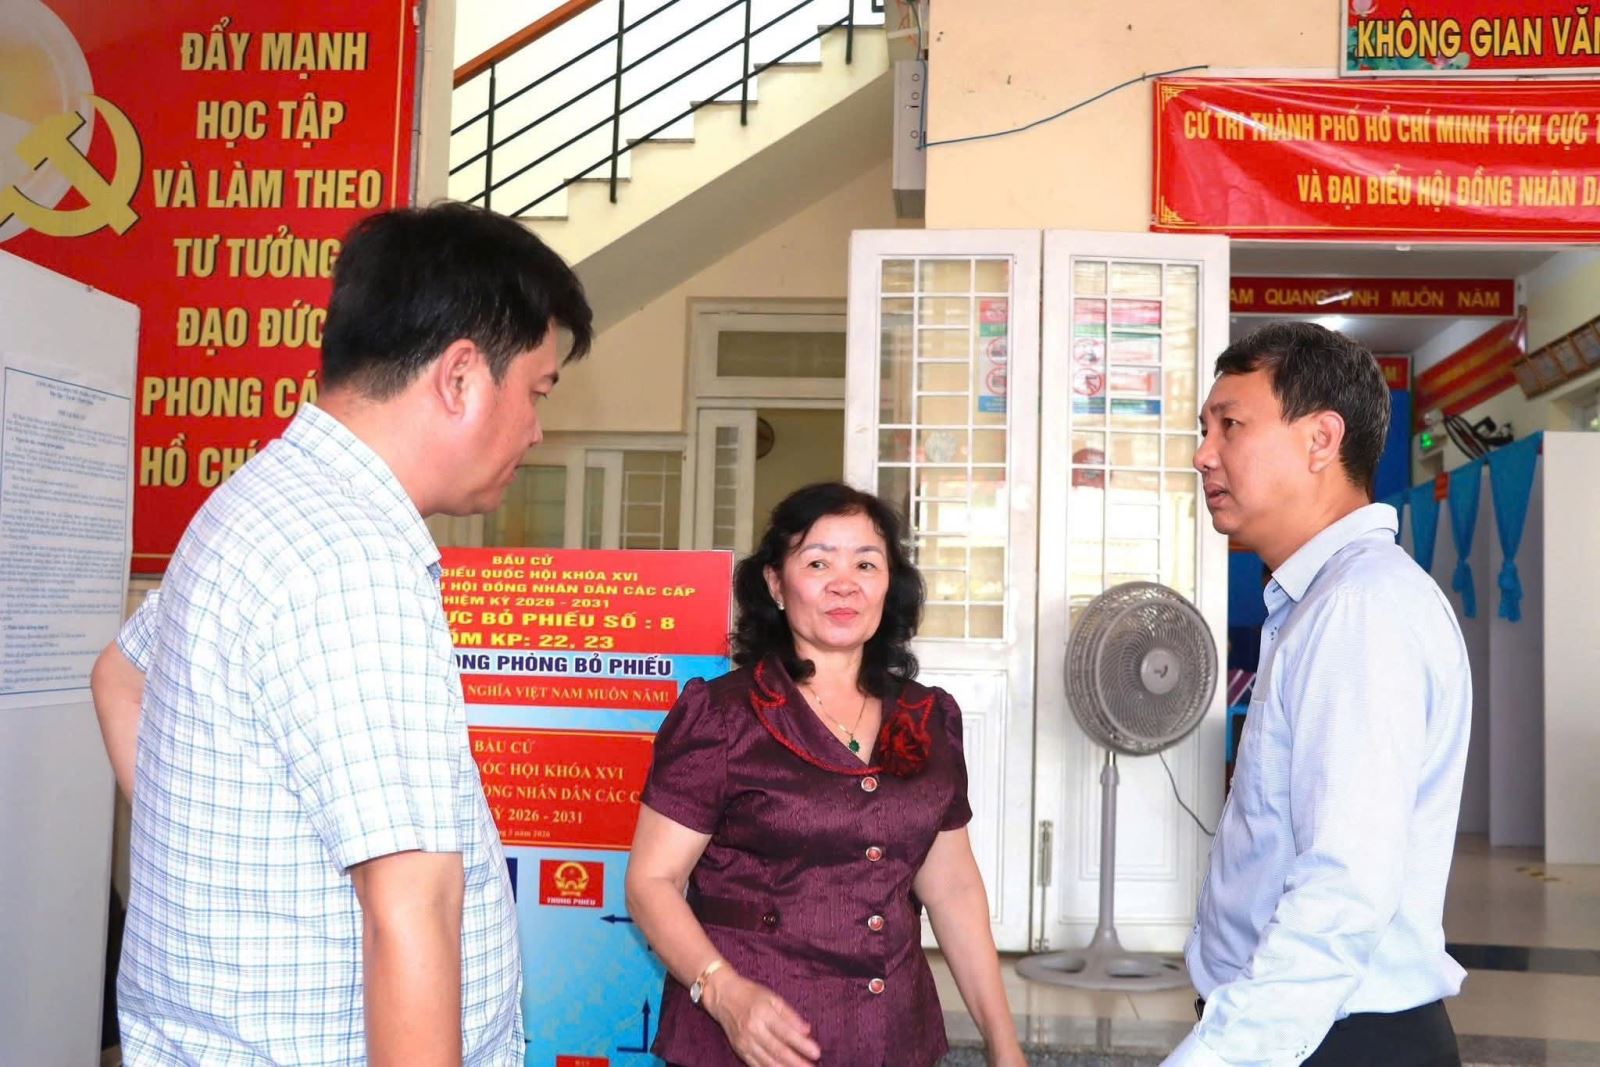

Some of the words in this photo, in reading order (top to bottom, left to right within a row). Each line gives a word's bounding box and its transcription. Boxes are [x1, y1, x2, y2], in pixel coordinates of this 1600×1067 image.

[1358, 9, 1461, 58] KHÔNG
[1470, 18, 1542, 57] GIAN
[1552, 7, 1600, 55] VĂ
[181, 16, 250, 71] ĐẨY
[260, 32, 368, 79] MẠNH
[196, 101, 267, 148] HỌC
[278, 92, 345, 148] TẬP
[1184, 102, 1211, 140] CỬ
[1215, 111, 1245, 141] TRI
[1251, 108, 1315, 142] THÀNH
[1320, 104, 1360, 142] PHỐ
[1365, 105, 1392, 143] HỒ
[1397, 108, 1431, 143] CHÍ
[1436, 114, 1490, 145] MINH
[1496, 108, 1541, 145] TÍCH
[1547, 110, 1589, 151] CỰC
[153, 161, 198, 209] VÀ
[207, 161, 284, 209] LÀM
[294, 168, 382, 209] THEO
[1297, 168, 1323, 203] VÀ
[1328, 175, 1361, 210] ĐẠI
[1367, 163, 1412, 206] BIỂU
[1417, 169, 1451, 213] HỘI
[1456, 165, 1512, 206] ĐỒNG
[1518, 169, 1576, 207] NHÂN
[173, 234, 220, 278] TƯ
[226, 225, 343, 278] TƯỞNG
[1230, 287, 1255, 306] AM
[1391, 285, 1444, 307] MUÔN
[1458, 287, 1500, 308] NĂM
[177, 307, 248, 357] ĐẠO
[258, 300, 328, 349] ĐỨC
[141, 376, 263, 418] PHONG
[273, 369, 320, 418] CÁ
[140, 432, 187, 488] HỒ
[481, 566, 525, 579] QUỐC
[530, 568, 557, 581] HỘI
[612, 571, 638, 582] XVI
[451, 580, 478, 592] HỘI
[482, 581, 528, 593] ĐỒNG
[532, 582, 579, 594] NHÂN
[584, 583, 618, 595] DÂN
[662, 584, 696, 597] CẤP
[443, 594, 485, 607] HIỆM
[515, 597, 555, 607] 2026
[571, 598, 609, 609] 2031
[481, 608, 514, 626] BỎ
[522, 610, 595, 628] PHIẾU
[603, 611, 637, 629] SỐ
[660, 616, 675, 630] 8
[584, 635, 614, 650] 23
[497, 652, 567, 673] PHÒNG
[575, 653, 602, 673] BỎ
[609, 655, 671, 676] PHIẾU
[468, 682, 512, 698] NGHĨA
[515, 684, 547, 700] VIỆT
[552, 686, 583, 699] NAM
[587, 686, 630, 701] MUÔN
[510, 763, 539, 779] HỘI
[544, 761, 591, 779] KHÓA
[595, 767, 623, 780] XVI
[516, 783, 557, 800] NHÂN
[561, 783, 591, 801] DÂN
[595, 786, 626, 803] CÁC
[508, 808, 540, 822] 2026
[552, 810, 582, 824] 2031
